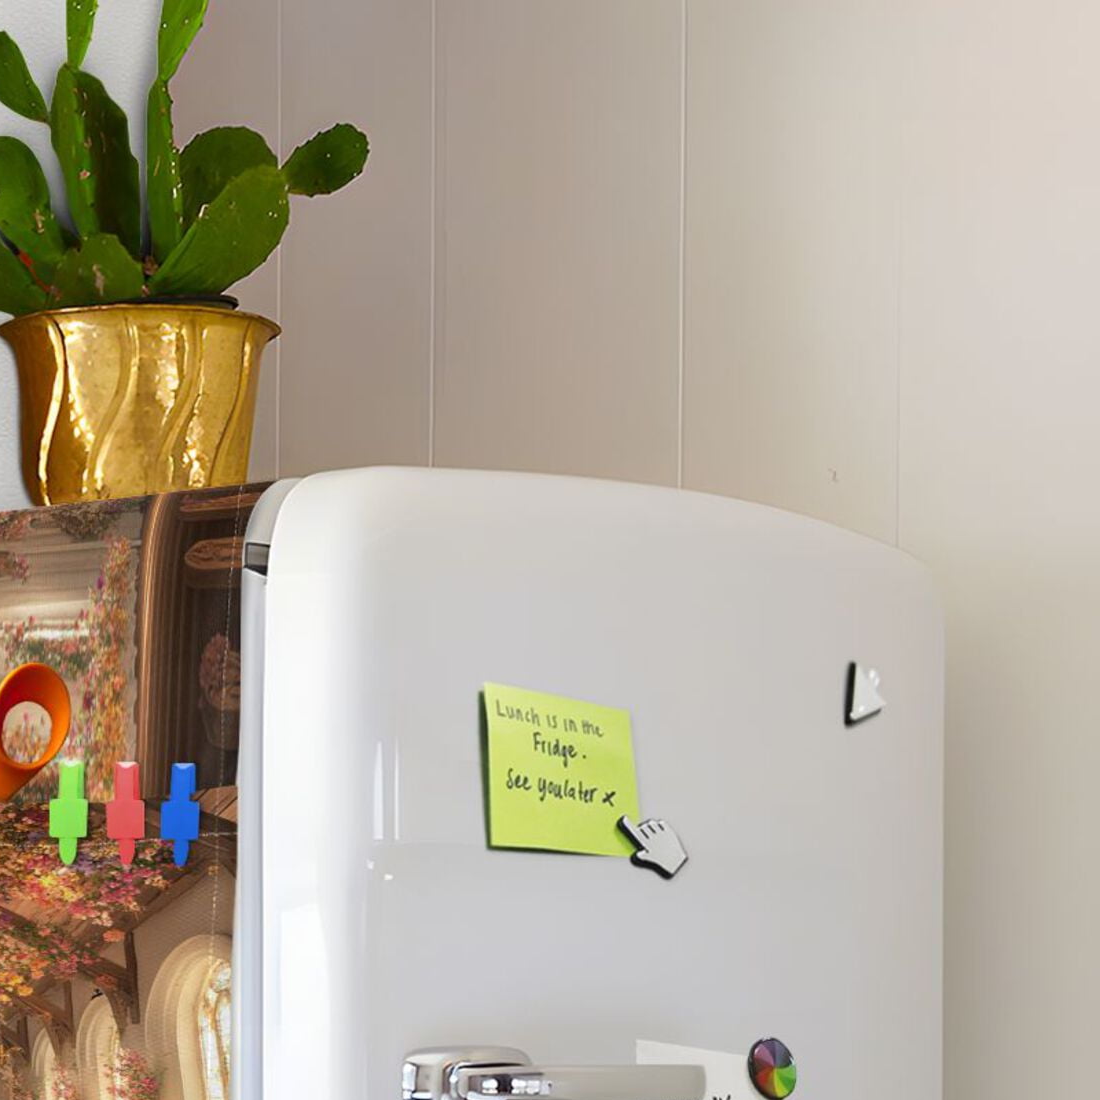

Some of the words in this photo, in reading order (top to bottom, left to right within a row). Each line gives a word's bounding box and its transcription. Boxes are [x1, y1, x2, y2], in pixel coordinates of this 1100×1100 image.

[496, 699, 540, 727] Lunch
[546, 714, 558, 729] is
[563, 718, 578, 733] in
[581, 719, 604, 738] the
[506, 767, 532, 790] See
